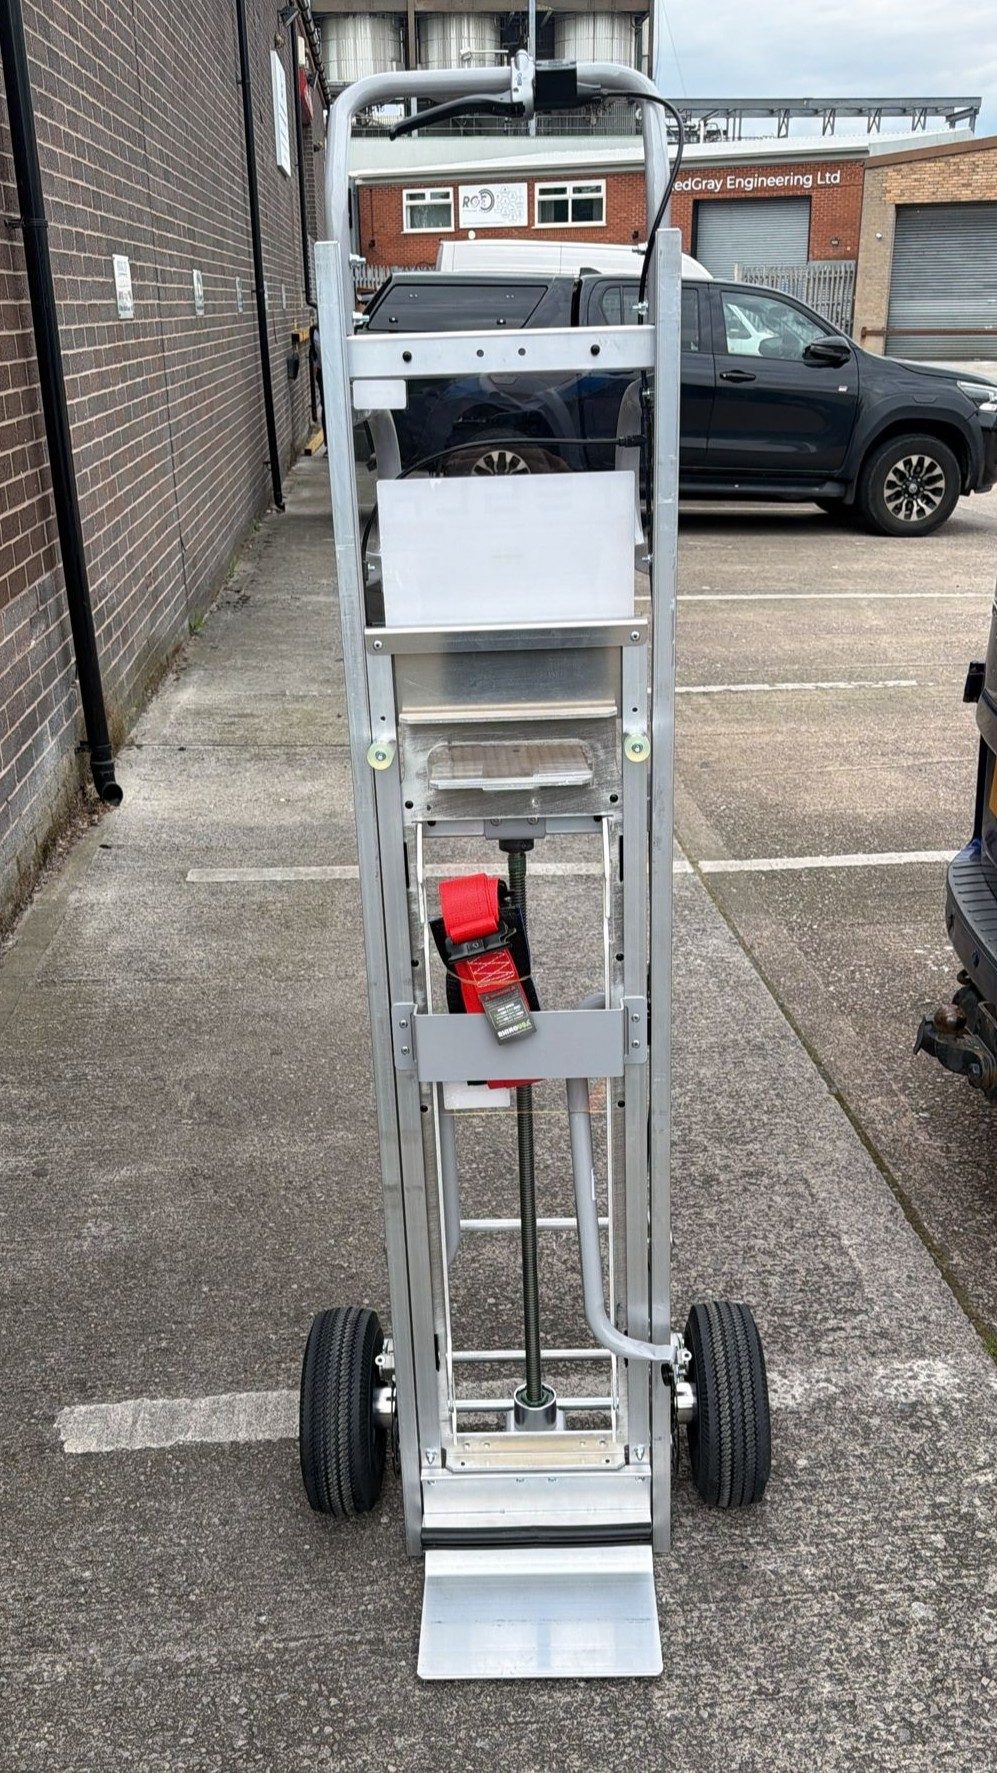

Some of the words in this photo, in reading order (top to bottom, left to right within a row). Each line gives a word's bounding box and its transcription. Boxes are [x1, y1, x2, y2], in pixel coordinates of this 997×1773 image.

[671, 177, 723, 192] edGray
[726, 172, 813, 191] Engineering
[817, 169, 841, 185] Ltd
